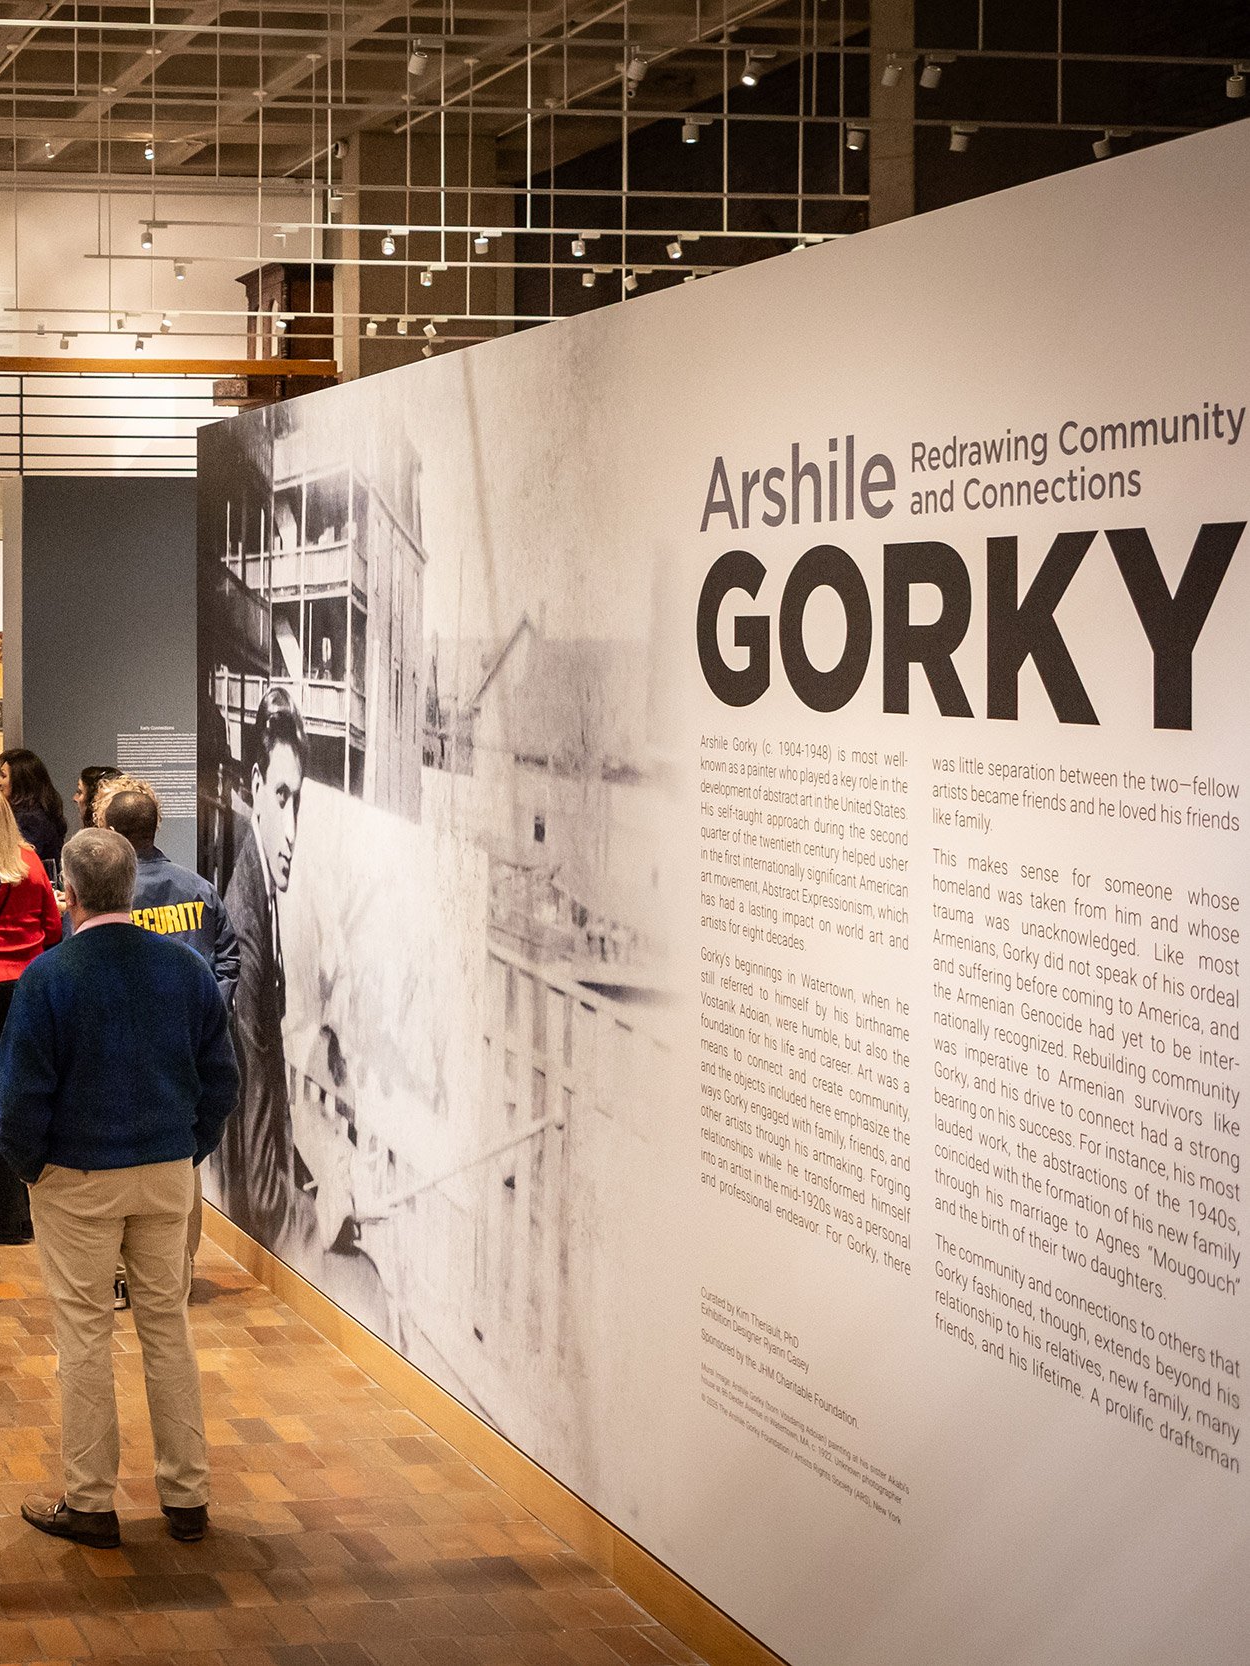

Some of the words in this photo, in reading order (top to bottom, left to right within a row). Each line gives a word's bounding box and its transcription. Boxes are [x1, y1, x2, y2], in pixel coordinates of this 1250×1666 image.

[911, 428, 1049, 473] Redrawing
[1059, 401, 1247, 456] Community
[700, 435, 896, 533] Arshile
[910, 480, 955, 515] and
[963, 464, 1142, 511] Connections
[696, 521, 1248, 731] GORKY
[700, 734, 728, 750] Arshile
[732, 736, 757, 756] Gorky
[837, 746, 846, 762] is
[851, 750, 878, 765] most
[884, 751, 908, 767] well-
[700, 756, 726, 773] known
[728, 762, 738, 774] as
[740, 764, 745, 775] a
[747, 763, 776, 779] painter
[779, 765, 798, 781] who
[799, 767, 830, 787] played
[832, 774, 838, 786] a
[840, 771, 856, 792] key
[859, 774, 878, 790] role
[880, 776, 888, 792] in
[891, 777, 908, 794] the
[932, 758, 955, 772] was
[959, 756, 984, 775] little
[988, 762, 1055, 782] separation
[1059, 764, 1118, 788] between
[1123, 769, 1146, 790] the
[700, 779, 751, 800] development
[753, 786, 761, 800] of
[763, 787, 798, 805] abstract
[800, 793, 812, 807] art
[814, 794, 822, 808] in
[824, 794, 838, 811] the
[841, 796, 871, 815] United
[932, 782, 967, 800] artists
[970, 784, 1019, 806] became
[1022, 789, 1066, 812] friends
[1070, 795, 1094, 815] and
[1098, 797, 1115, 818] he
[1118, 799, 1156, 822] loved
[1160, 803, 1182, 825] his
[1186, 806, 1239, 832] friends
[932, 807, 952, 826] like
[954, 810, 992, 835] family.
[700, 801, 714, 816] His
[718, 805, 762, 826] self-taught
[766, 814, 809, 831] approach
[814, 817, 844, 840] during
[849, 823, 865, 840] the
[870, 829, 908, 846] second
[700, 826, 729, 841] quarter
[732, 829, 740, 843] of
[743, 830, 757, 846] the
[759, 834, 800, 854] twentieth
[804, 843, 838, 864] century
[842, 846, 875, 868] helped
[879, 854, 908, 872] usher
[700, 846, 708, 860] in
[709, 847, 722, 863] the
[724, 849, 740, 866] first
[742, 854, 804, 882] internationally
[807, 866, 856, 888] significant
[859, 874, 908, 898] American
[700, 870, 712, 883] art
[713, 874, 761, 895] movement,
[762, 880, 799, 901] Abstract
[802, 888, 876, 918] Expressionism,
[878, 904, 908, 924] which
[934, 847, 957, 867] This
[967, 854, 1008, 875] makes
[1020, 864, 1059, 883] sense
[1072, 867, 1090, 888] for
[1104, 877, 1172, 902] someone
[1187, 886, 1240, 912] whose
[129, 901, 204, 935] ECURITY
[700, 890, 716, 907] has
[718, 894, 735, 911] had
[738, 902, 744, 913] a
[748, 900, 778, 924] lasting
[782, 908, 814, 930] impact
[818, 919, 831, 933] on
[836, 923, 864, 940] world
[868, 930, 883, 945] art
[888, 933, 909, 950] and
[700, 915, 727, 932] artists
[728, 918, 740, 935] for
[742, 924, 764, 943] eight
[765, 927, 807, 951] decades.
[932, 874, 990, 900] homeland
[997, 889, 1023, 906] was
[1030, 891, 1066, 914] taken
[1074, 897, 1107, 921] from
[1114, 904, 1142, 927] him
[1150, 912, 1178, 934] and
[1187, 917, 1240, 945] whose
[932, 902, 974, 924] trauma
[985, 914, 1010, 932] was
[1021, 921, 1140, 958] unacknowledged.
[1154, 941, 1184, 966] Like
[1198, 954, 1239, 977] most
[933, 927, 999, 958] Armenians,
[1002, 941, 1039, 970] Gorky
[1044, 949, 1064, 971] did
[1068, 958, 1090, 977] not
[1095, 964, 1137, 987] speak
[1142, 970, 1157, 992] of
[1162, 973, 1184, 998] his
[1190, 982, 1239, 1009] ordeal
